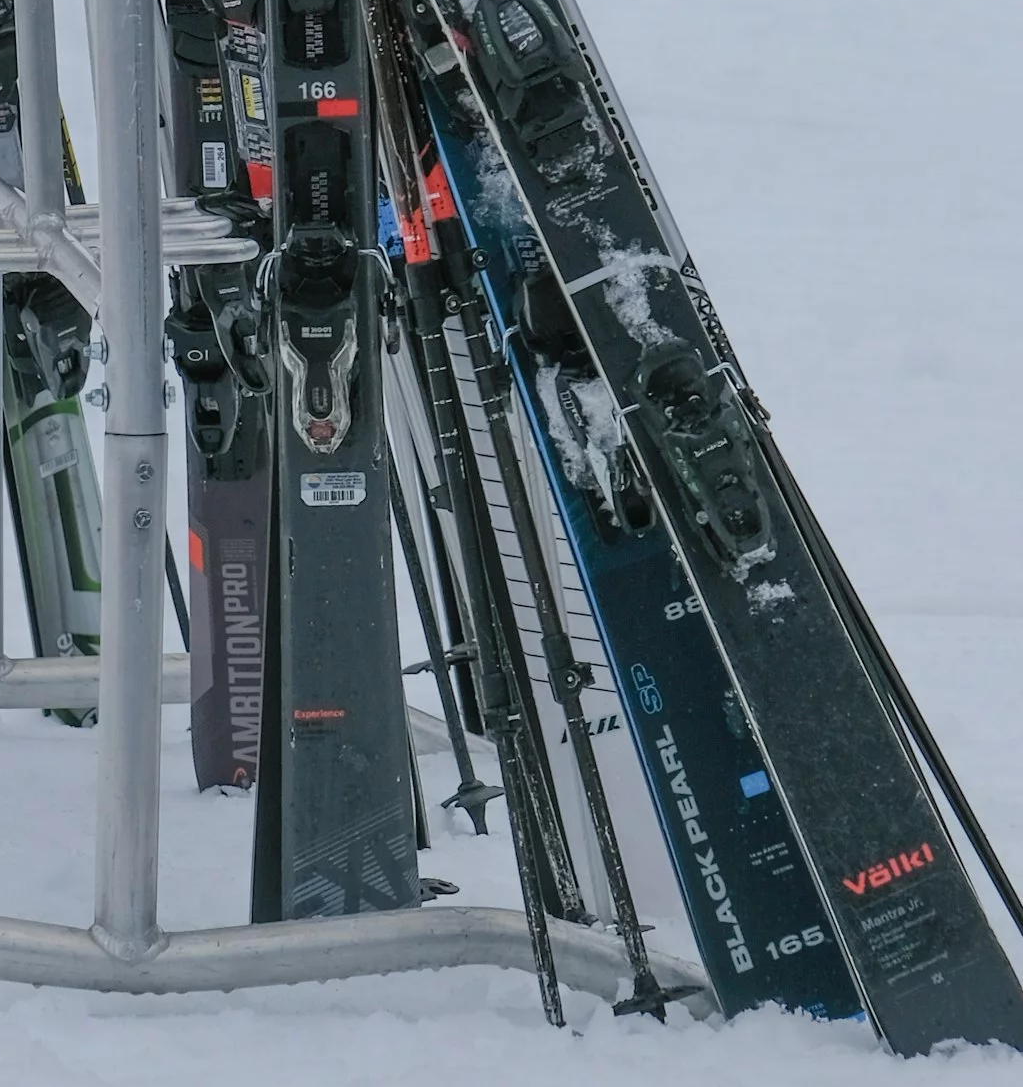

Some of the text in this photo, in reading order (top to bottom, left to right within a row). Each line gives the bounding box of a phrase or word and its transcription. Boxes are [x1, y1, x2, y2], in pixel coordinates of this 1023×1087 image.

[298, 81, 337, 100] 166
[294, 709, 345, 719] Experience
[630, 663, 754, 975] BLACK PEARL SP
[861, 905, 906, 932] Mantra
[765, 926, 825, 962] 165
